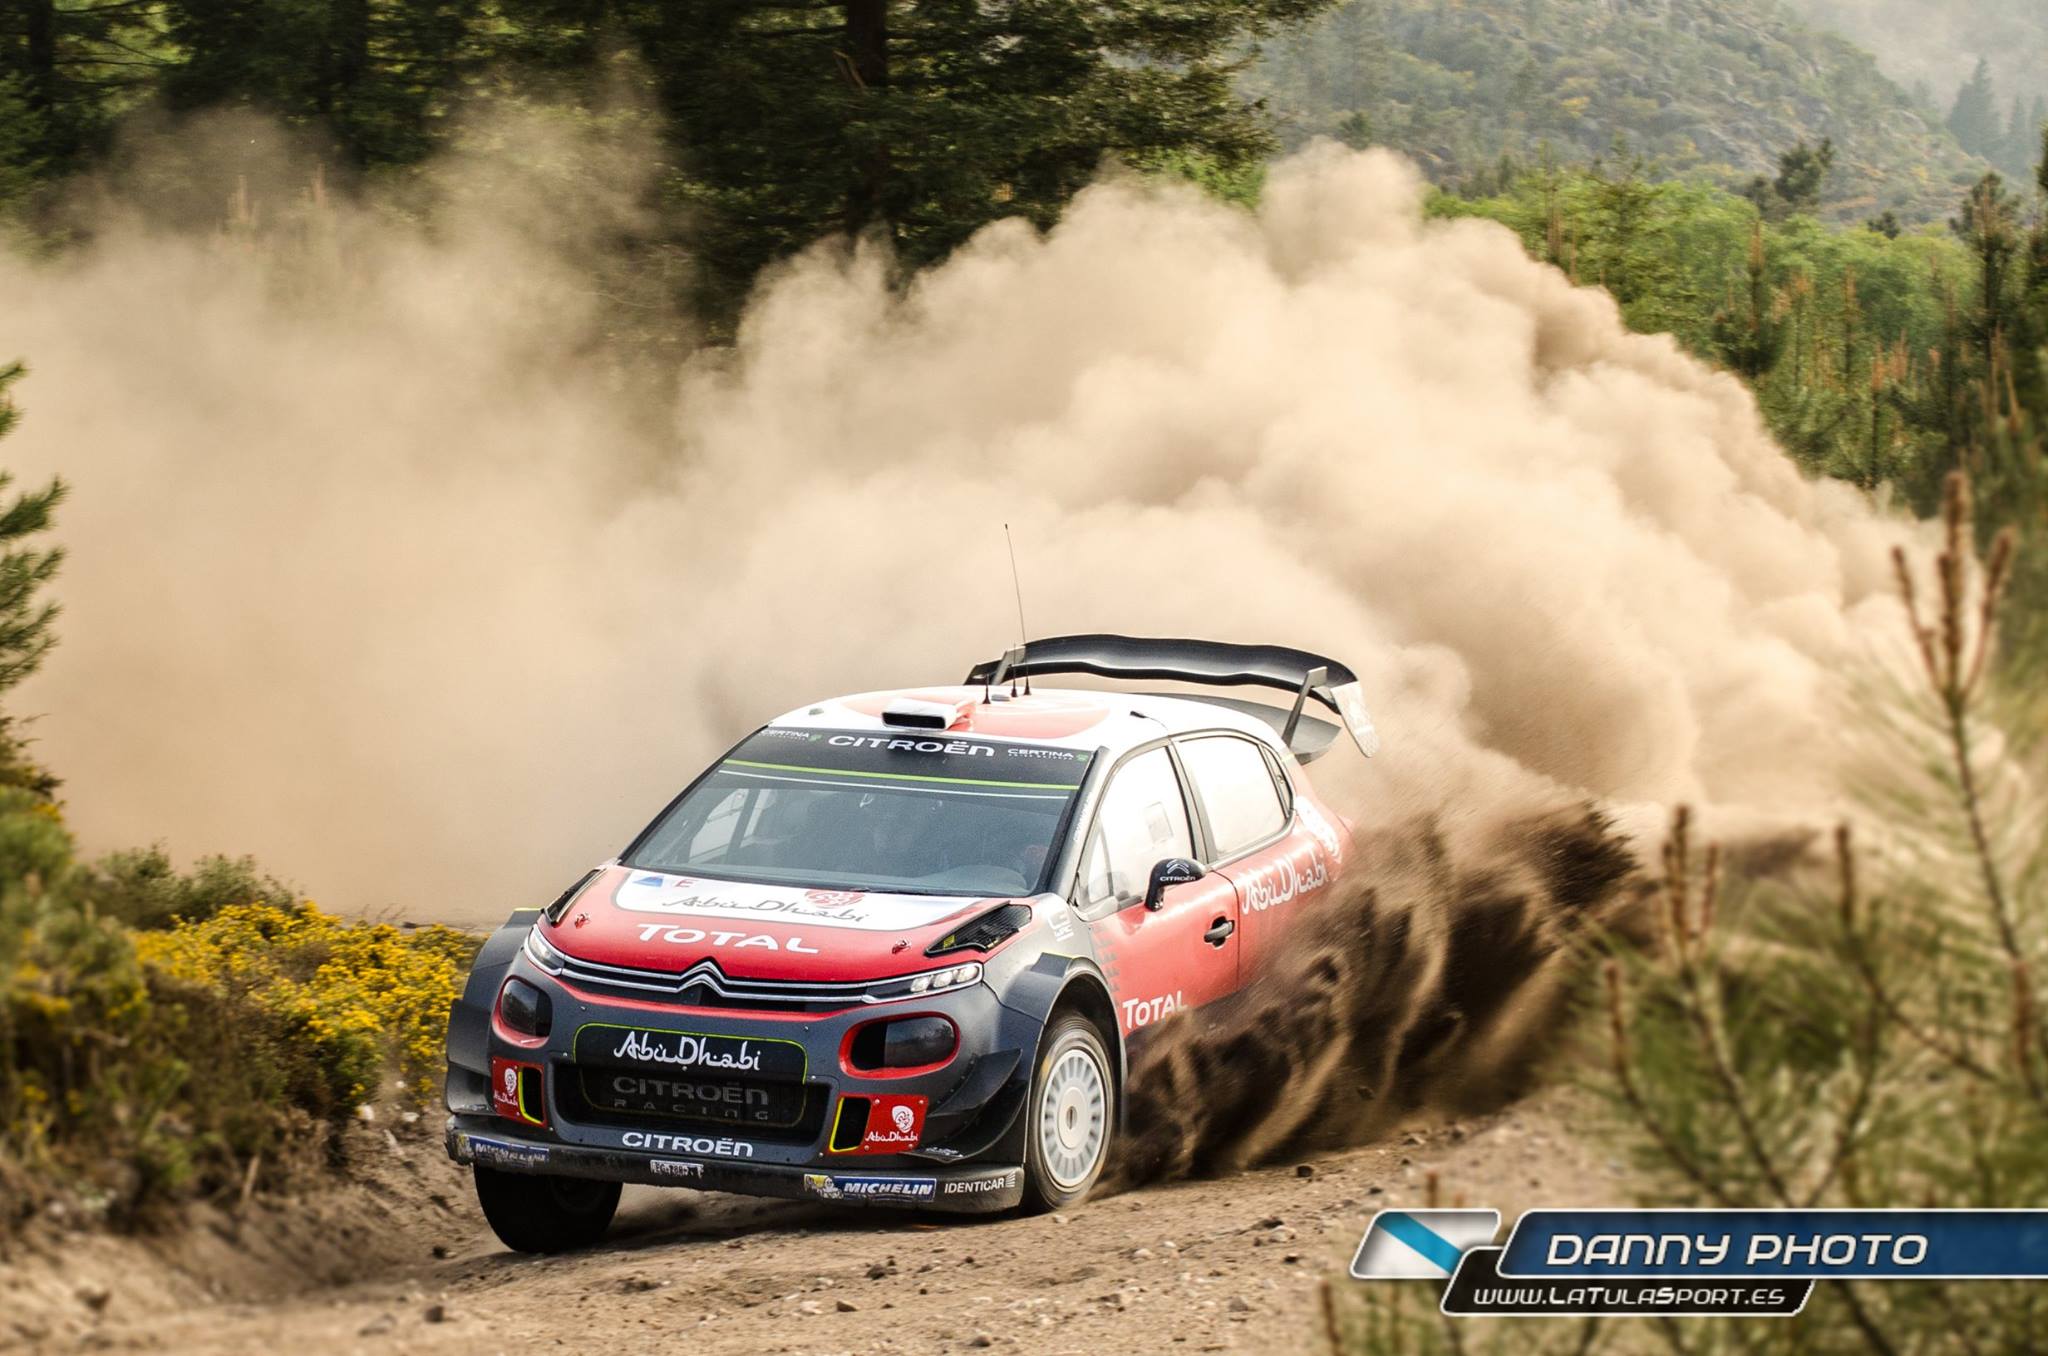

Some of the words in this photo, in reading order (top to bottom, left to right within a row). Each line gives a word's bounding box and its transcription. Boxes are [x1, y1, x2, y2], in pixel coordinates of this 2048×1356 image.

[828, 735, 995, 757] CITROËN
[1007, 748, 1075, 759] CERTINA
[749, 899, 869, 922] Dhabi
[637, 923, 819, 954] TOTAL
[1122, 990, 1188, 1029] TOTAL
[613, 1030, 675, 1063] Abu
[675, 1036, 761, 1071] Dhabi
[612, 1076, 769, 1106] CITROËN
[614, 1098, 769, 1121] RACING
[622, 1131, 754, 1157] CITROËN
[889, 1130, 919, 1142] Dhabi
[843, 1182, 933, 1195] MICHELIN
[944, 1177, 1005, 1194] IDENTICAR
